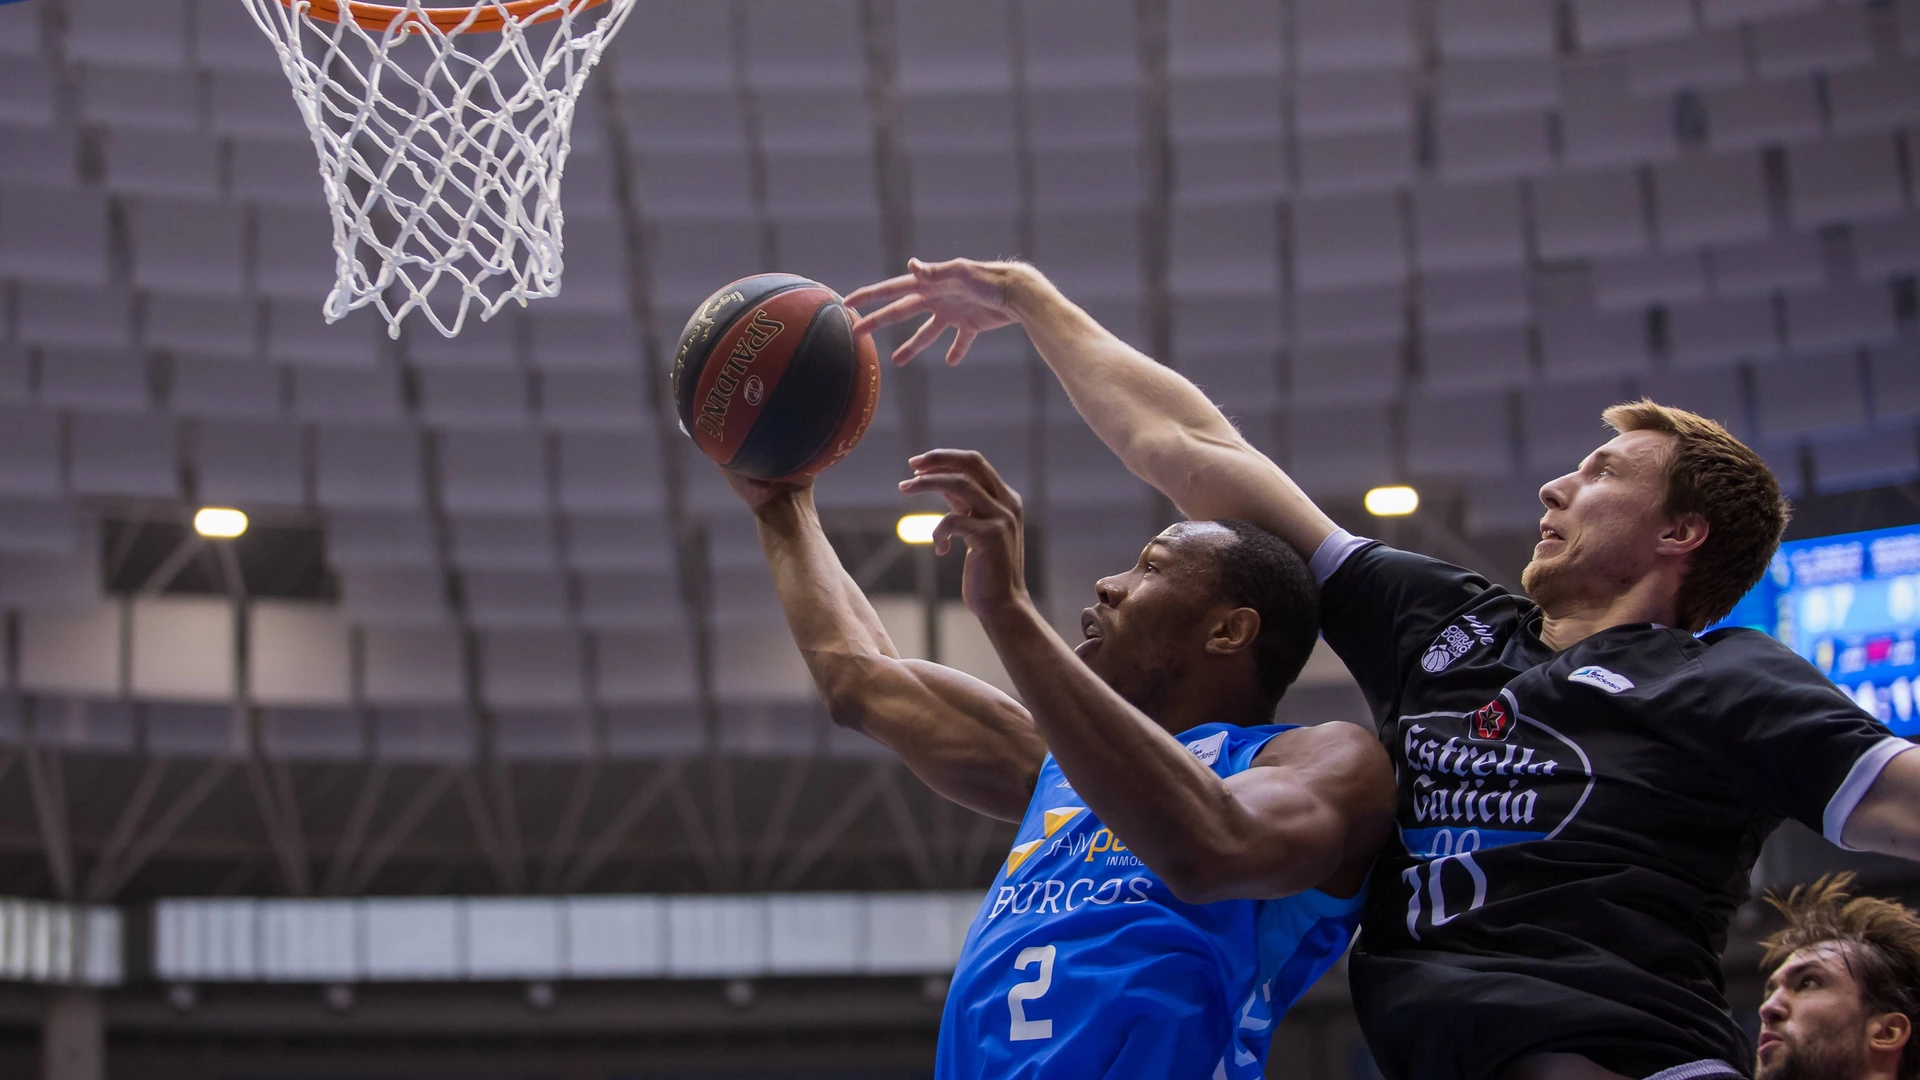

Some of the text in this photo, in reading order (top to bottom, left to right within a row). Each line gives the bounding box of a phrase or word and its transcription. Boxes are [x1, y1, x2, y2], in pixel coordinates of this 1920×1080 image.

[695, 308, 784, 442] SPALDING
[1440, 628, 1468, 653] DOIRO
[1448, 625, 1475, 650] OBRA
[1405, 724, 1559, 777] Estrella
[1413, 774, 1538, 824] Galicia
[1007, 944, 1057, 1041] 2
